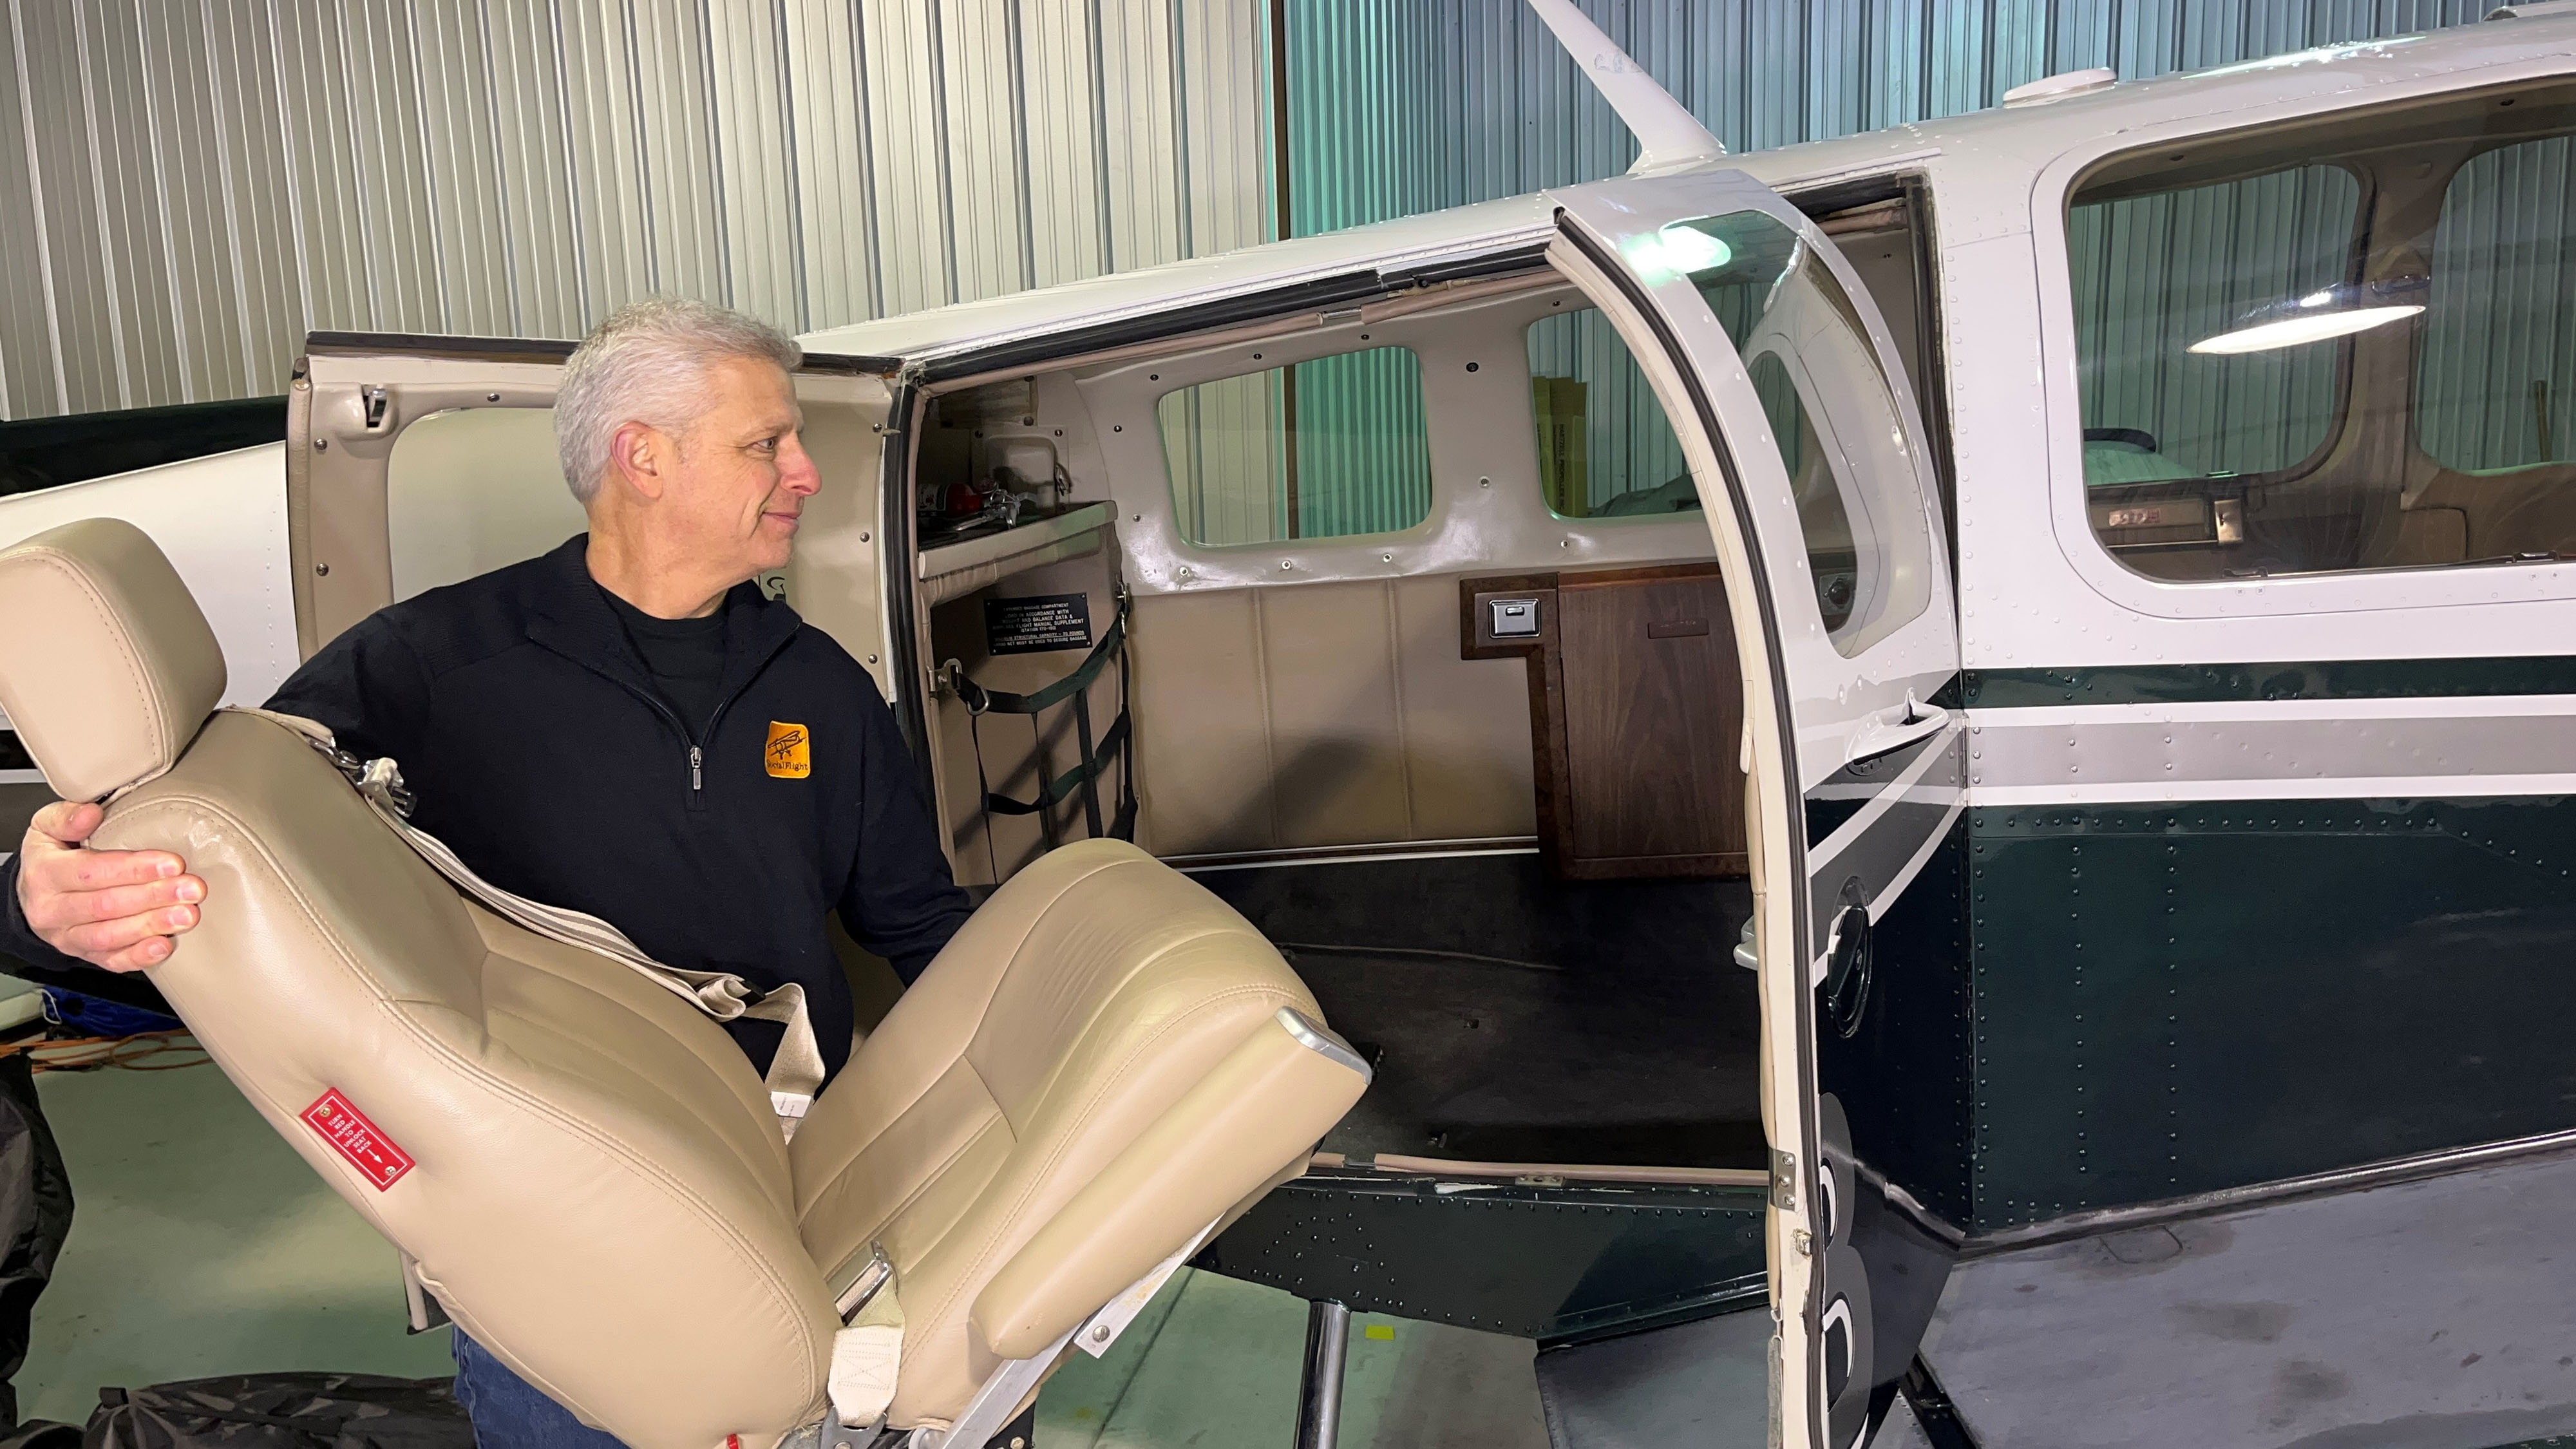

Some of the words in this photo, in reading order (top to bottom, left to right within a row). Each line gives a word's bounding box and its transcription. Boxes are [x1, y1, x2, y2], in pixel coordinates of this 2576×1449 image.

[328, 1113, 343, 1126] TURN
[334, 1119, 356, 1139] HANDLE
[343, 1128, 366, 1148] UNLOCK
[353, 1136, 366, 1148] SEAT
[356, 1140, 372, 1153] BACK
